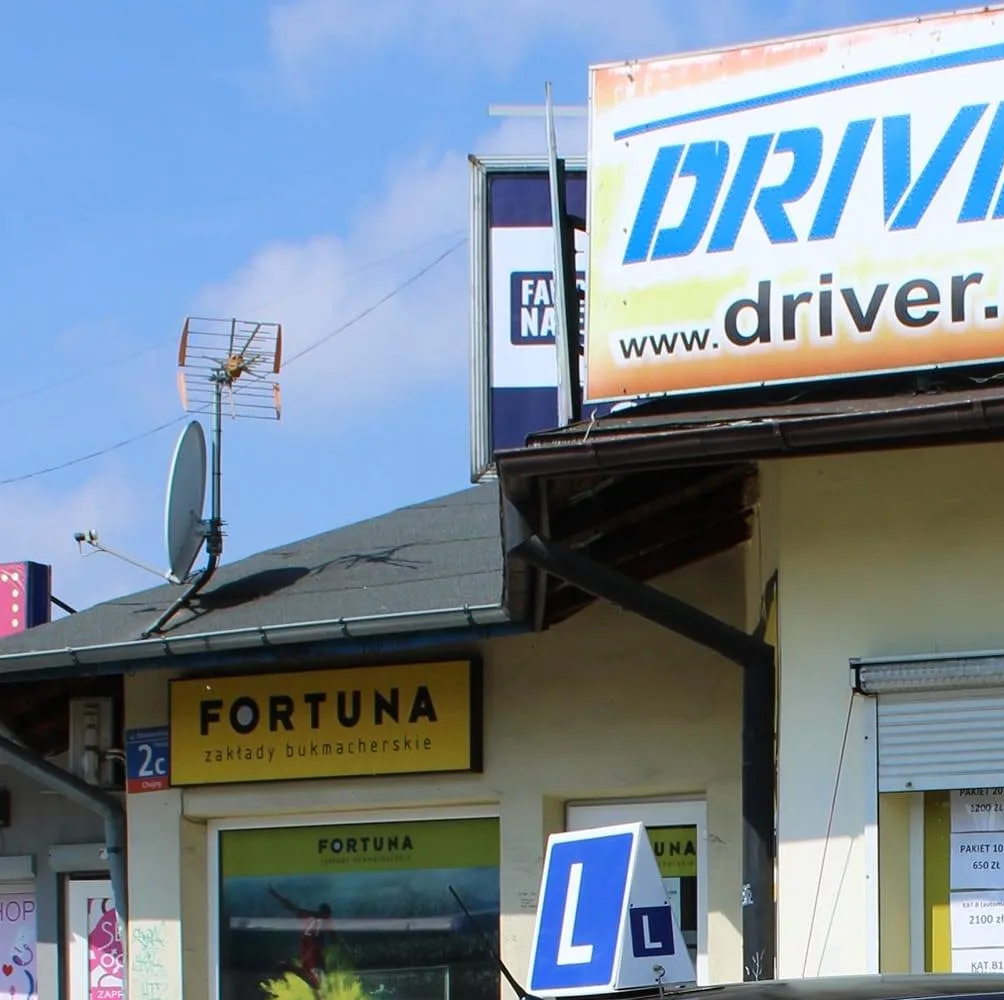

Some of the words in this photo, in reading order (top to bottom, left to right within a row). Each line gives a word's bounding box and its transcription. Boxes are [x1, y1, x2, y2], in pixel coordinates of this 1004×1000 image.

[521, 278, 555, 306] FA
[520, 306, 556, 337] NA
[200, 685, 438, 736] FORTUNA
[204, 743, 276, 763] zakłady
[286, 736, 432, 758] bukmacherskie
[317, 834, 414, 854] FORTUNA
[654, 840, 697, 857] UNA
[959, 844, 991, 853] PAKIET
[993, 844, 1004, 853] 10
[972, 861, 989, 870] 650
[556, 862, 594, 966] L
[968, 914, 994, 925] 2100
[642, 914, 663, 950] L
